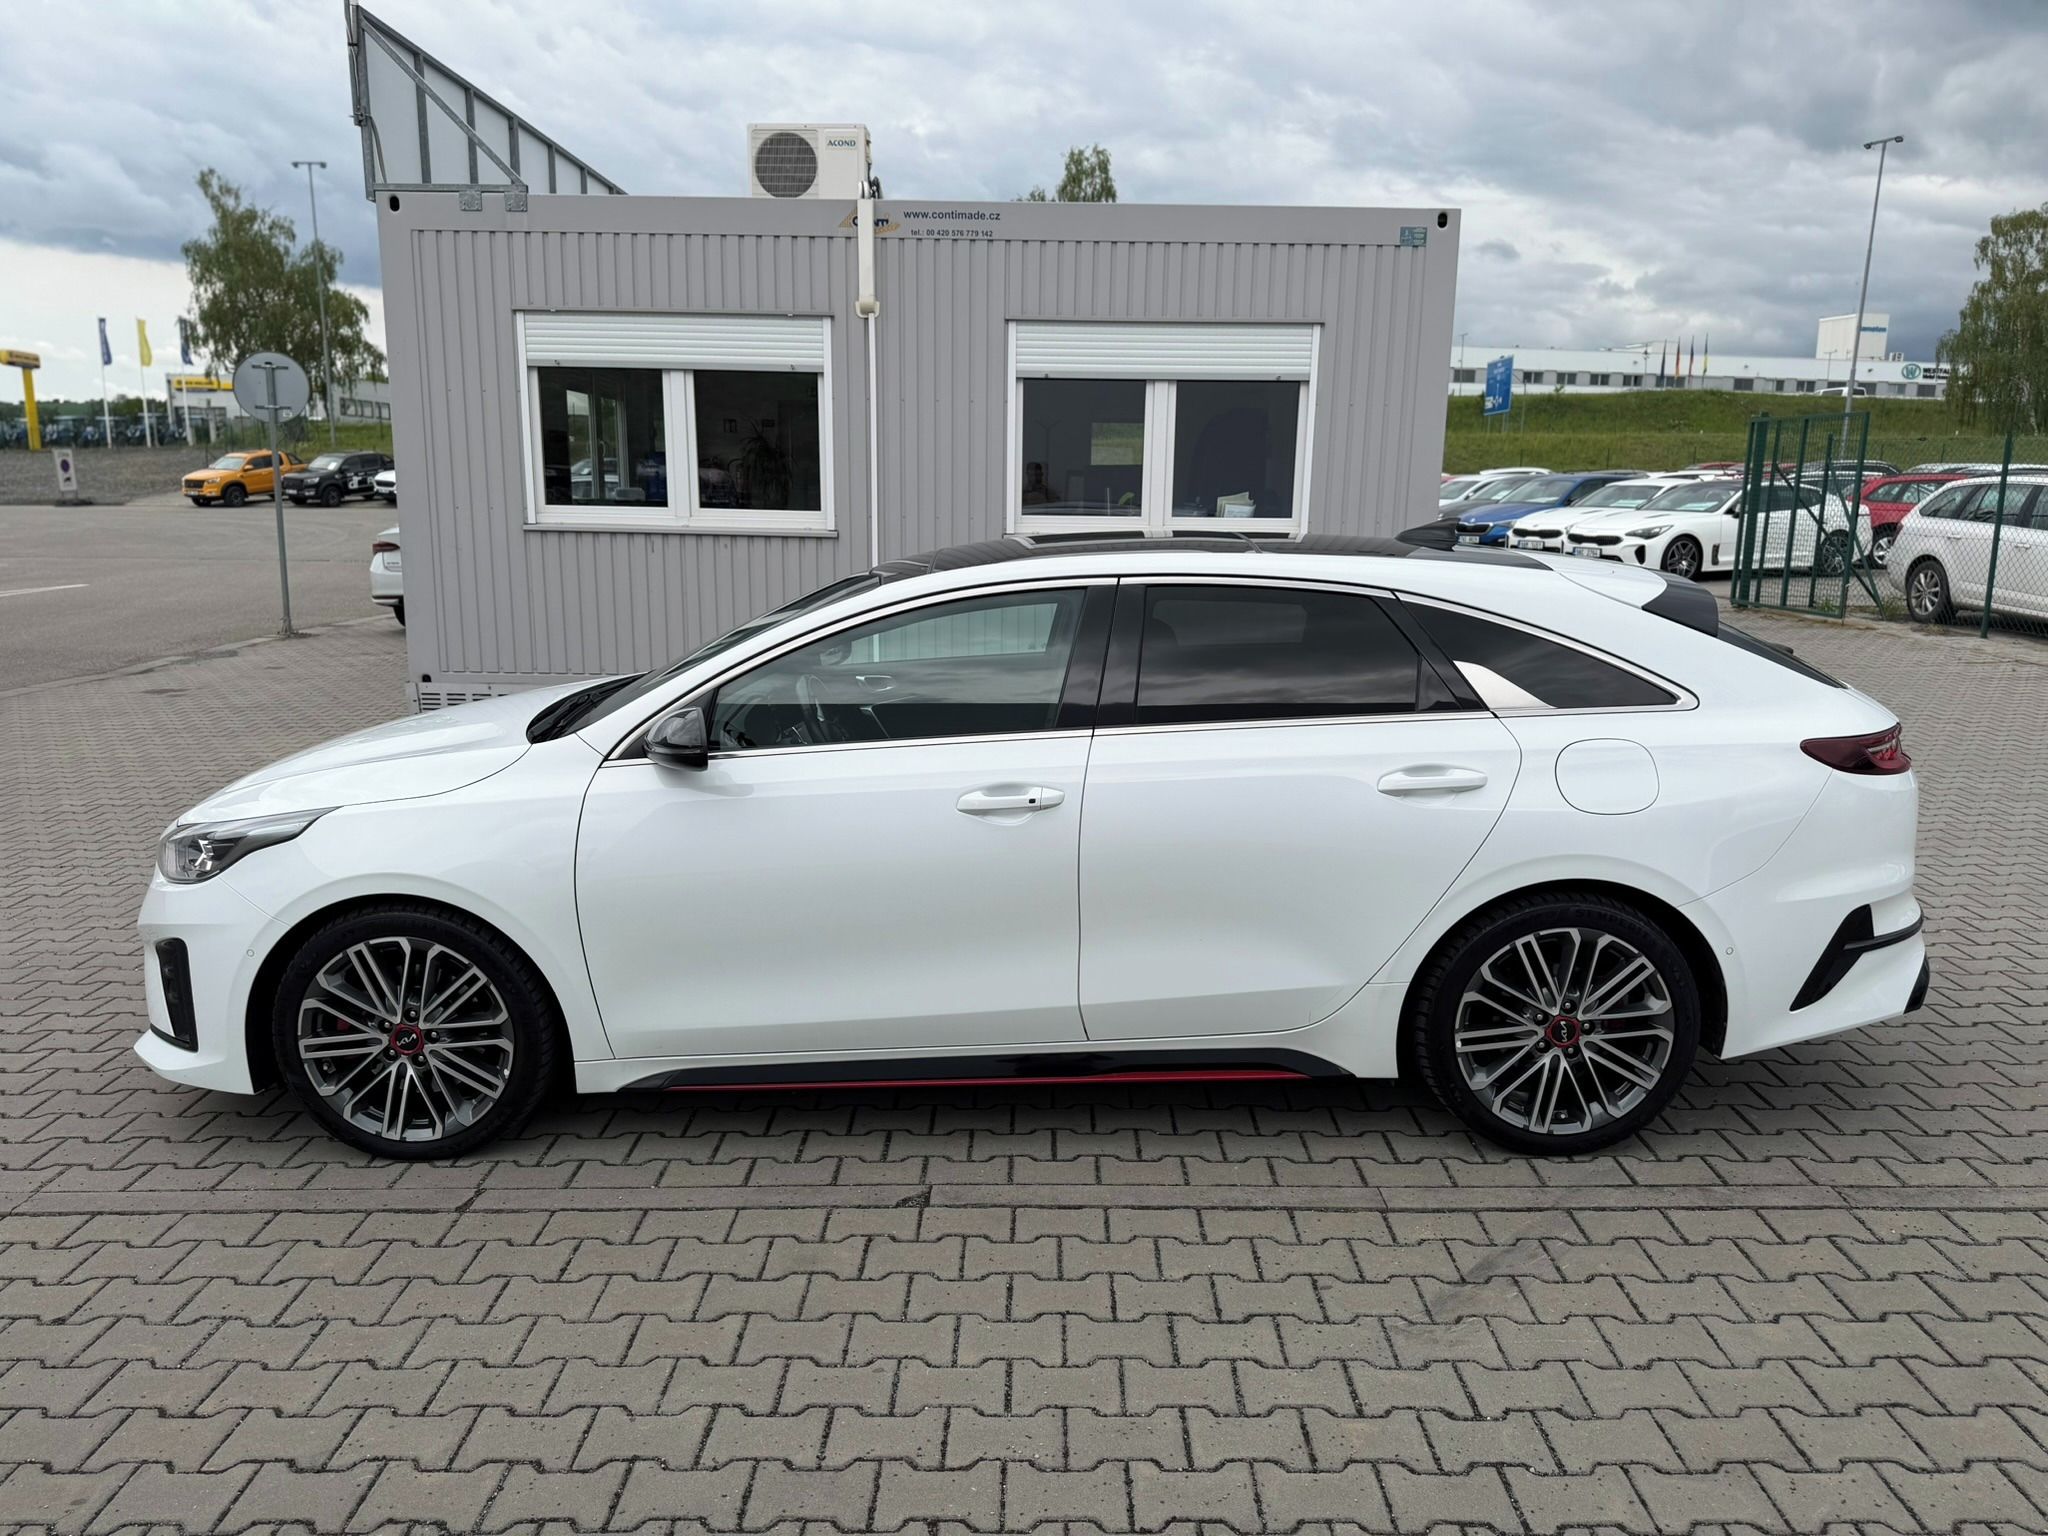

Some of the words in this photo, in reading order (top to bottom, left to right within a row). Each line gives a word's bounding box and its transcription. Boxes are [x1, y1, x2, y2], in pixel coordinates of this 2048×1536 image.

[827, 139, 856, 147] ACOND
[903, 210, 1001, 221] www.contimade.cz
[926, 229, 935, 237] 00
[936, 229, 950, 237] 420
[951, 229, 965, 237] 576
[981, 229, 994, 238] 142
